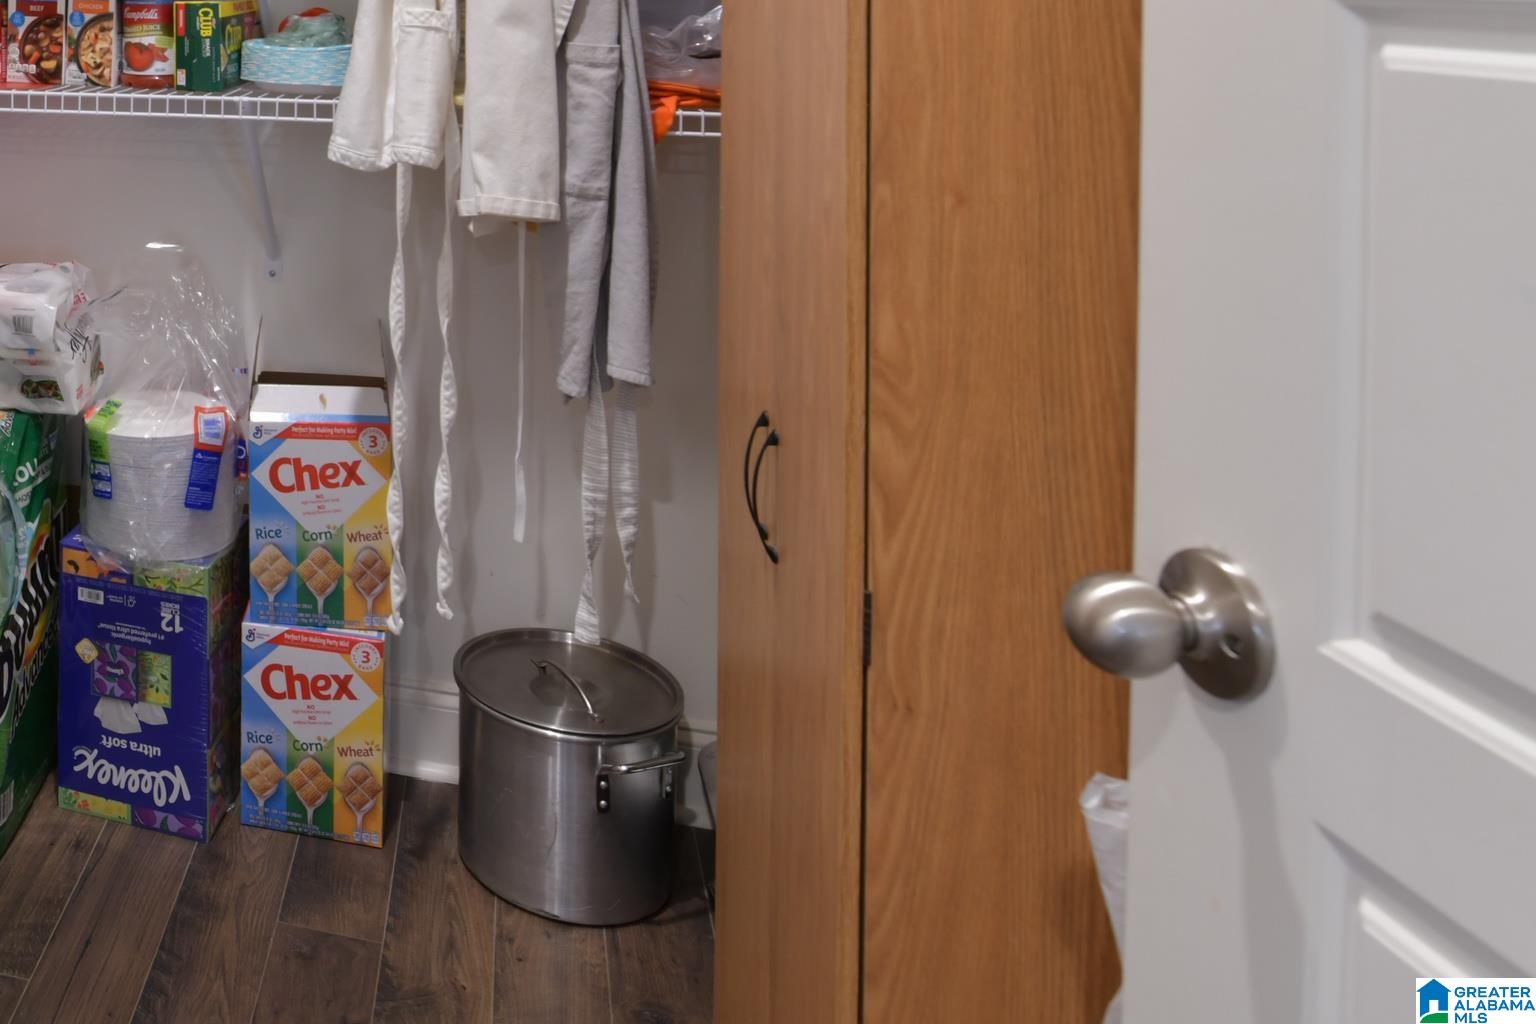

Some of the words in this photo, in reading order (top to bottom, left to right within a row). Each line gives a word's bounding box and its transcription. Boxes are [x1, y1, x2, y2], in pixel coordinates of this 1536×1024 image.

[124, 6, 160, 22] Campbell's
[198, 7, 214, 37] CLUB
[144, 24, 161, 32] JUICE
[291, 426, 308, 434] Perfect
[315, 426, 333, 435] Making
[333, 426, 346, 436] Party
[368, 435, 379, 449] 3
[268, 456, 366, 494] Chex
[255, 527, 283, 540] Rice
[302, 530, 333, 542] Corn
[346, 530, 384, 544] Wheat
[160, 614, 184, 634] 12
[283, 632, 301, 641] Perfect
[308, 636, 326, 645] Making
[326, 638, 338, 647] Party
[361, 650, 371, 664] 3
[260, 663, 359, 701] Chex
[100, 733, 126, 752] soft
[129, 744, 162, 758] ultra
[246, 731, 274, 744] Rice
[292, 739, 324, 752] Corn
[337, 745, 375, 757] Wheat
[73, 748, 191, 807] Kleenex
